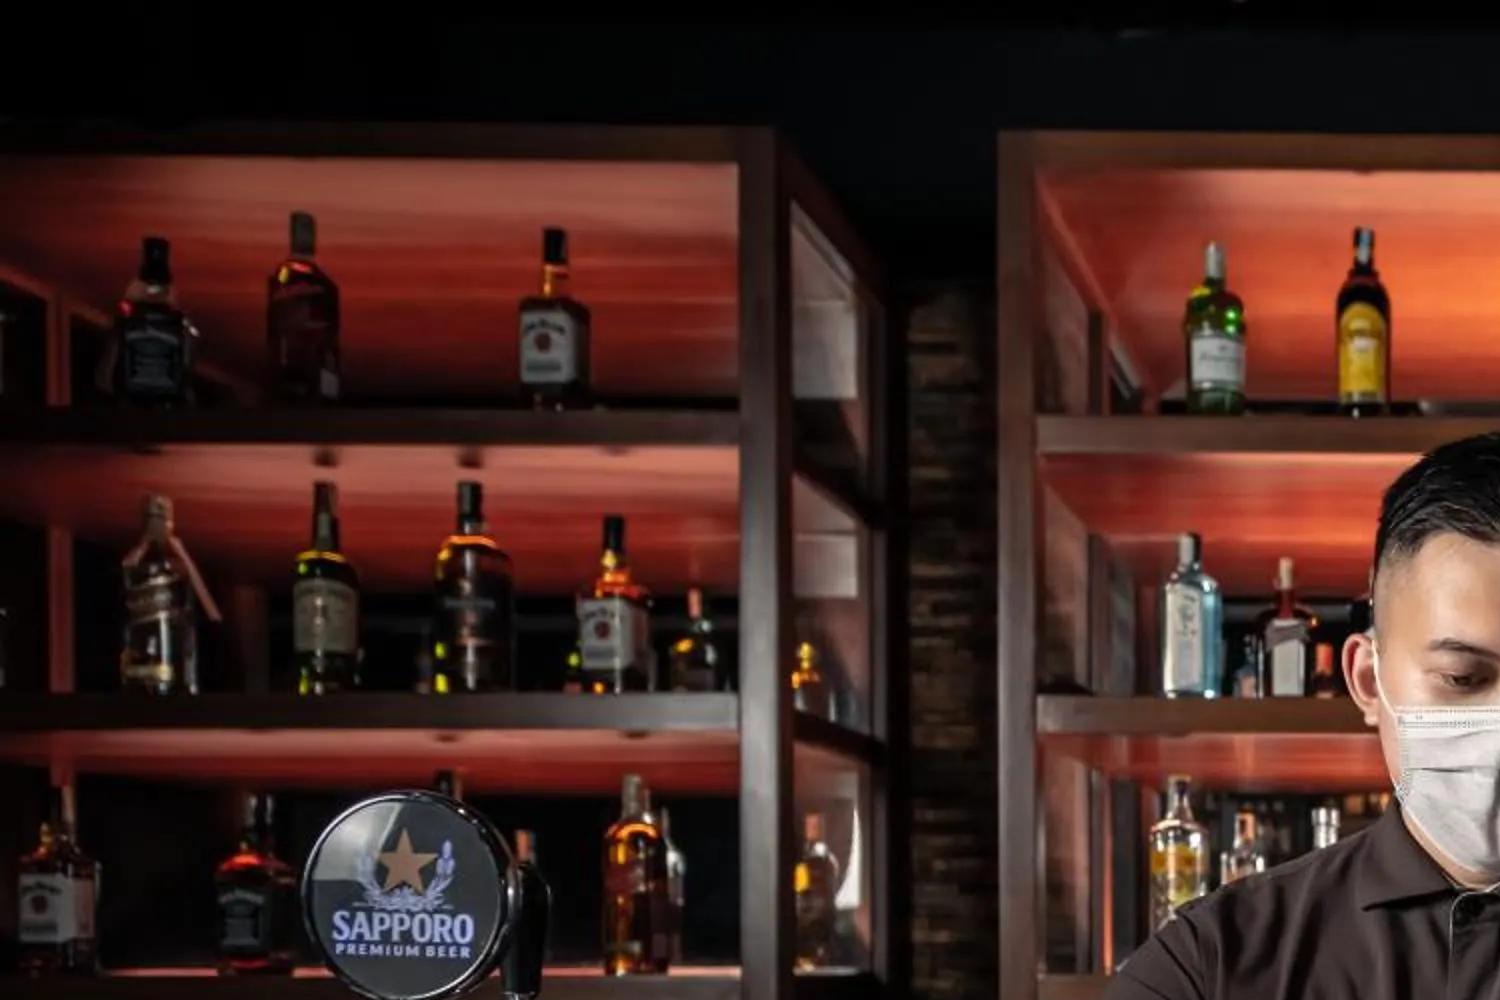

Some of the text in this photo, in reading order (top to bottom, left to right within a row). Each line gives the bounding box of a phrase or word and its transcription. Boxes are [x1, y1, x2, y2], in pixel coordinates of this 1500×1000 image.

[332, 910, 475, 944] SAPPORO
[335, 943, 471, 958] PREMIUM BEER
